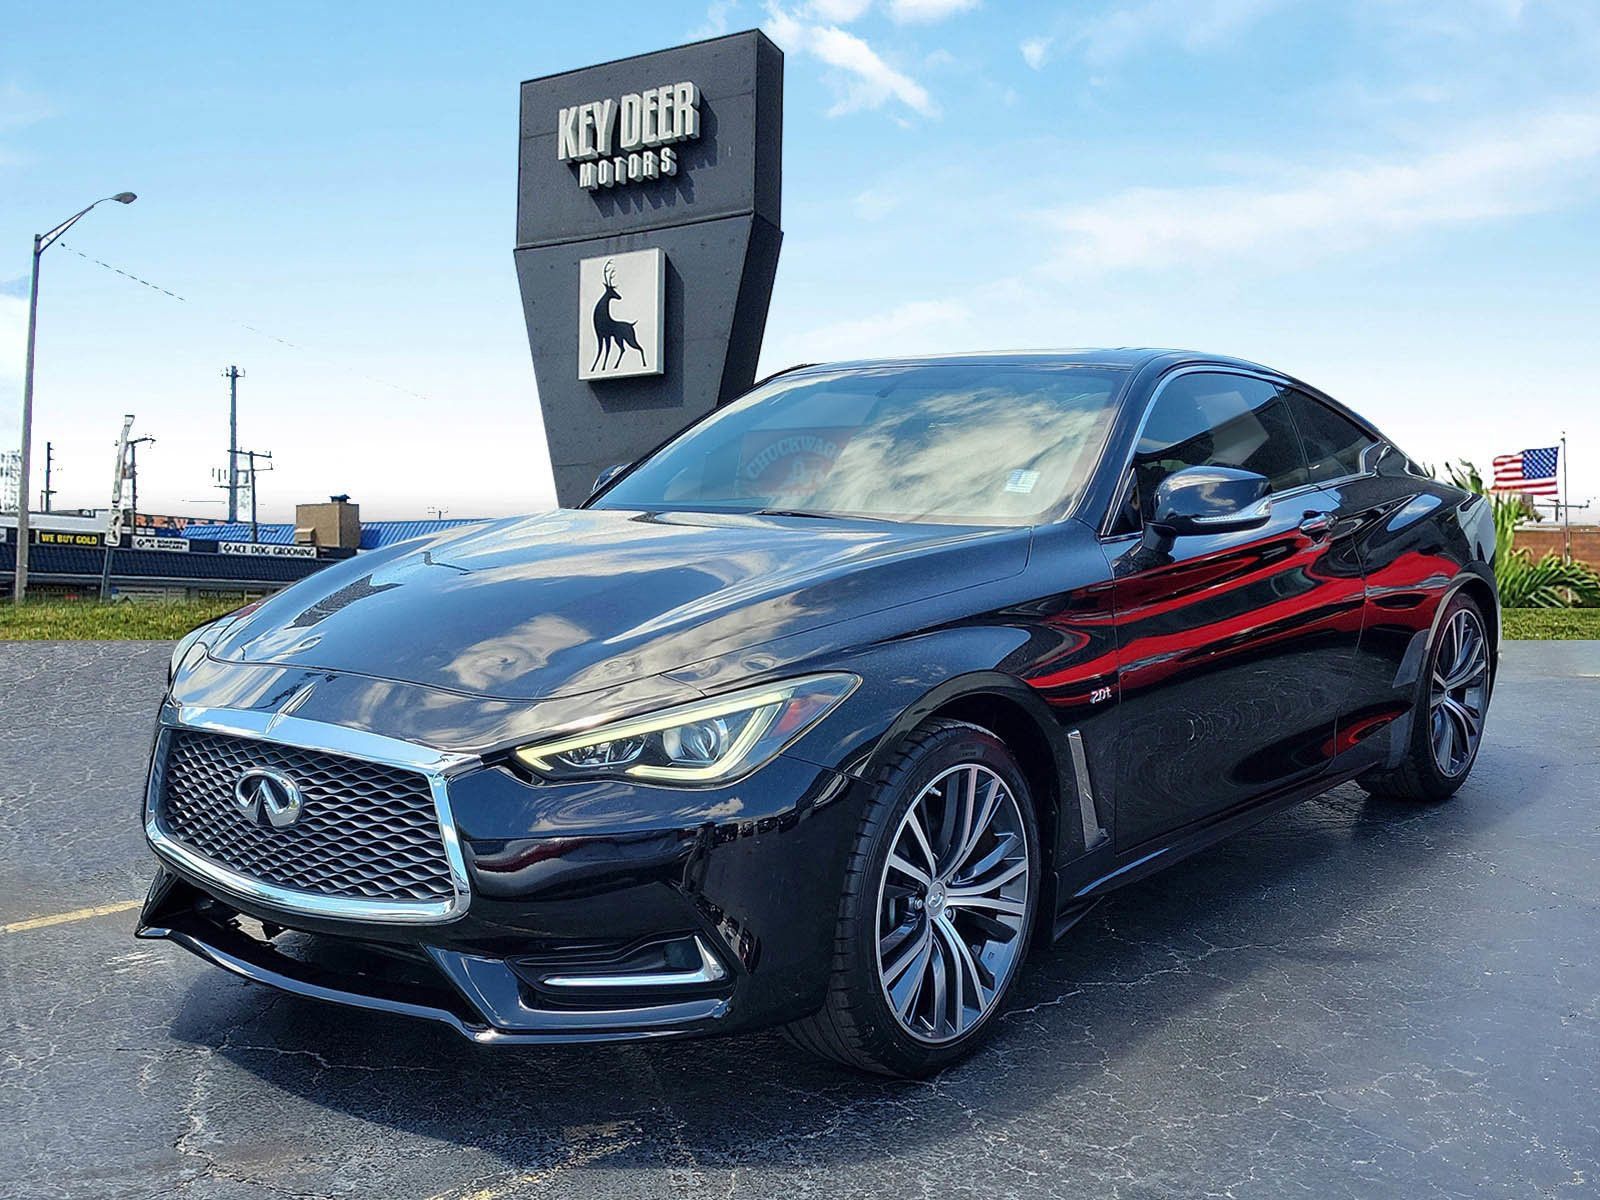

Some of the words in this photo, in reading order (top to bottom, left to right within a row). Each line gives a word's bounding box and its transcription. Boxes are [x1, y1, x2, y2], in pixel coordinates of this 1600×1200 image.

[558, 98, 617, 160] KEY
[620, 81, 700, 151] DEER
[579, 147, 677, 190] MOTORS
[746, 435, 838, 479] CHUCKWAG
[41, 533, 55, 543] WE
[57, 534, 74, 544] BUY
[76, 535, 98, 545] GOLD
[232, 544, 247, 553] ACE
[251, 545, 270, 555] DOG
[273, 547, 315, 557] GROOMING
